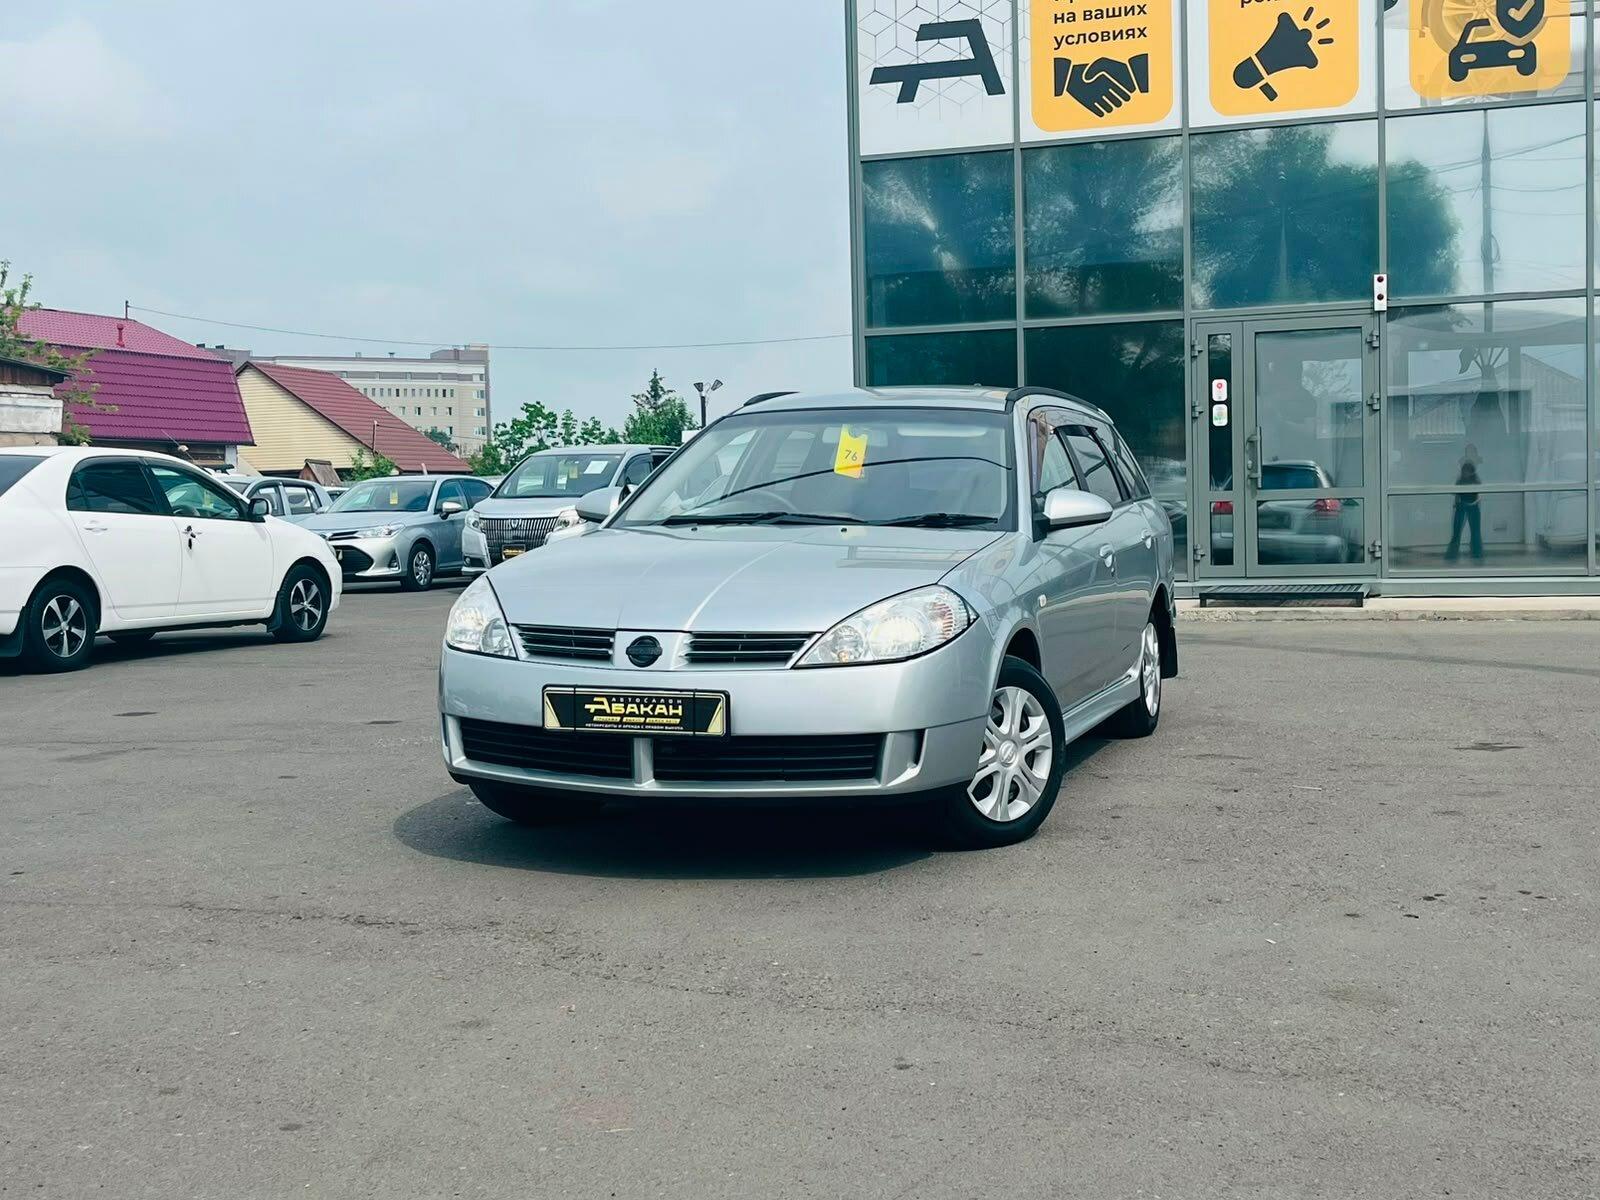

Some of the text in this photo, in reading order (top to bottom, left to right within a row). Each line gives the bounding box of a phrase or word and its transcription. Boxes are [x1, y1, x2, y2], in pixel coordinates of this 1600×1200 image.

[1053, 4, 1147, 24] на ваших
[1053, 26, 1147, 51] условиях
[845, 449, 857, 461] 76
